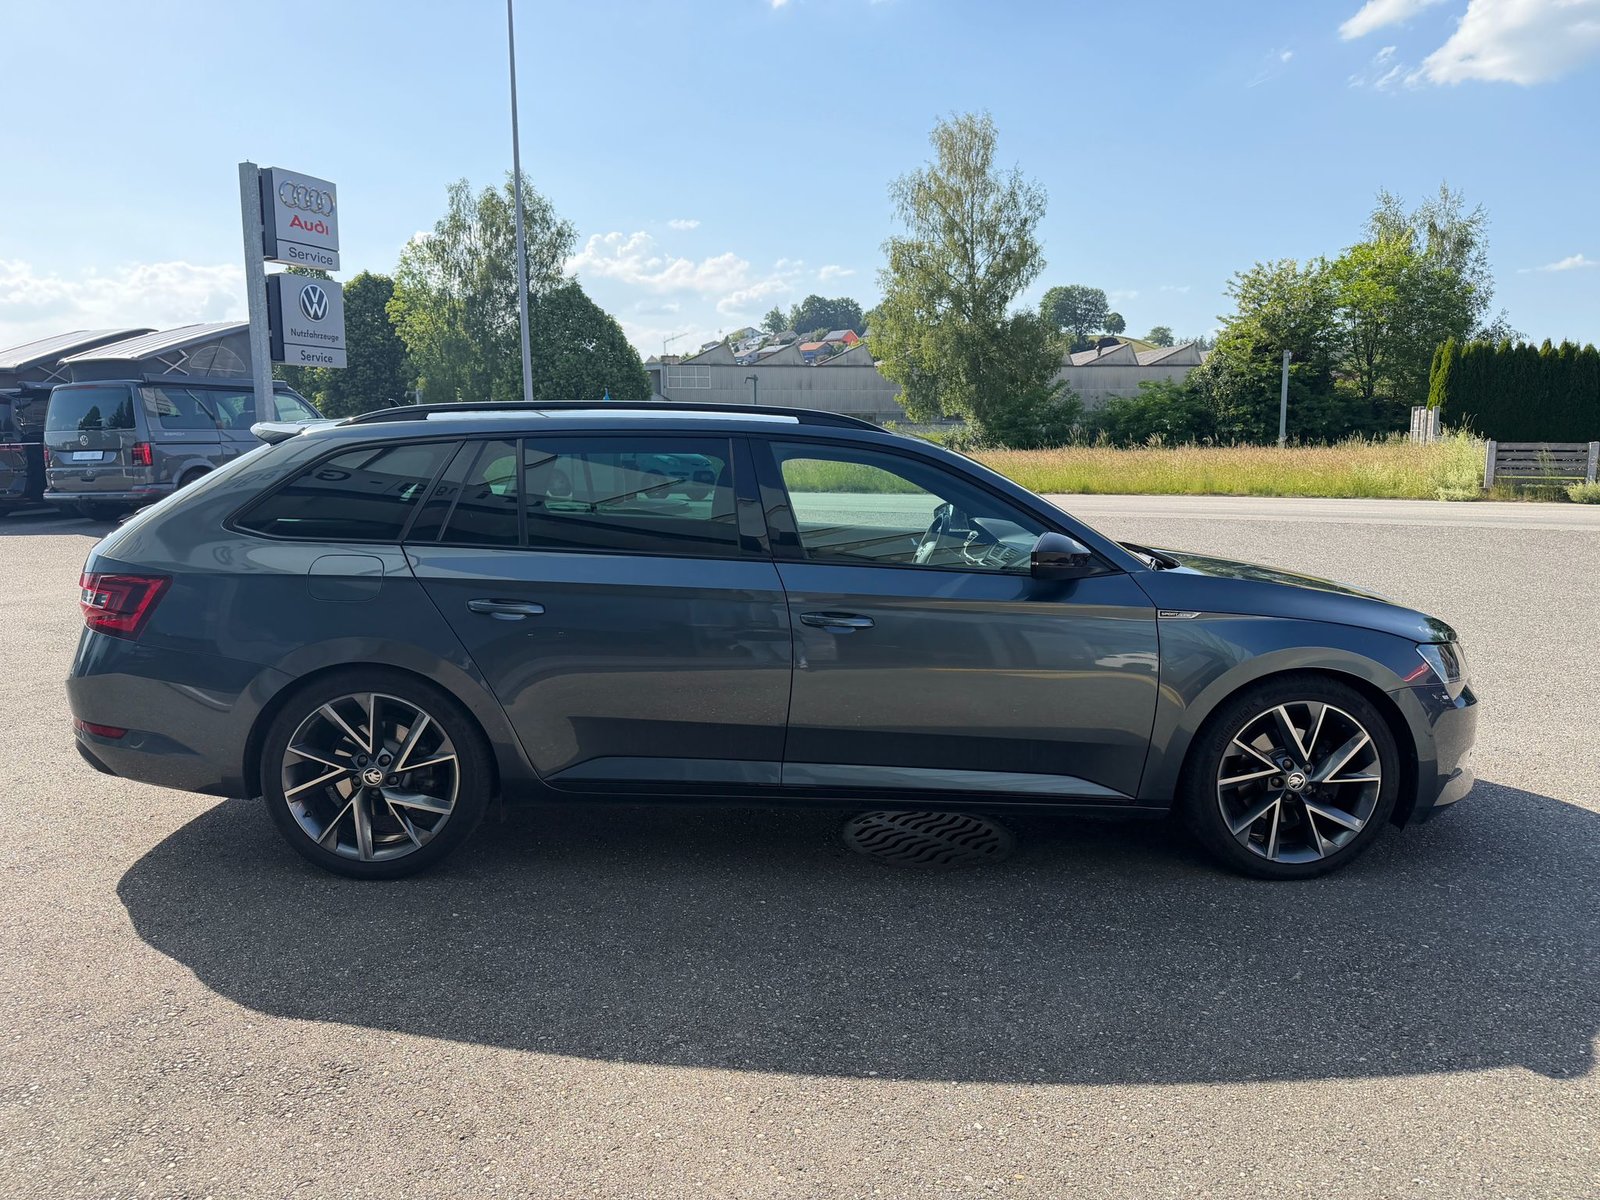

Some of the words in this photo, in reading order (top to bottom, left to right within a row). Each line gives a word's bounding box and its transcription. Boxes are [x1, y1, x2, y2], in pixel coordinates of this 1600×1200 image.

[289, 214, 329, 235] Audi
[288, 246, 333, 266] Service
[300, 284, 329, 323] VW
[290, 327, 340, 343] Nutzfahrzeuge
[300, 349, 333, 363] Service
